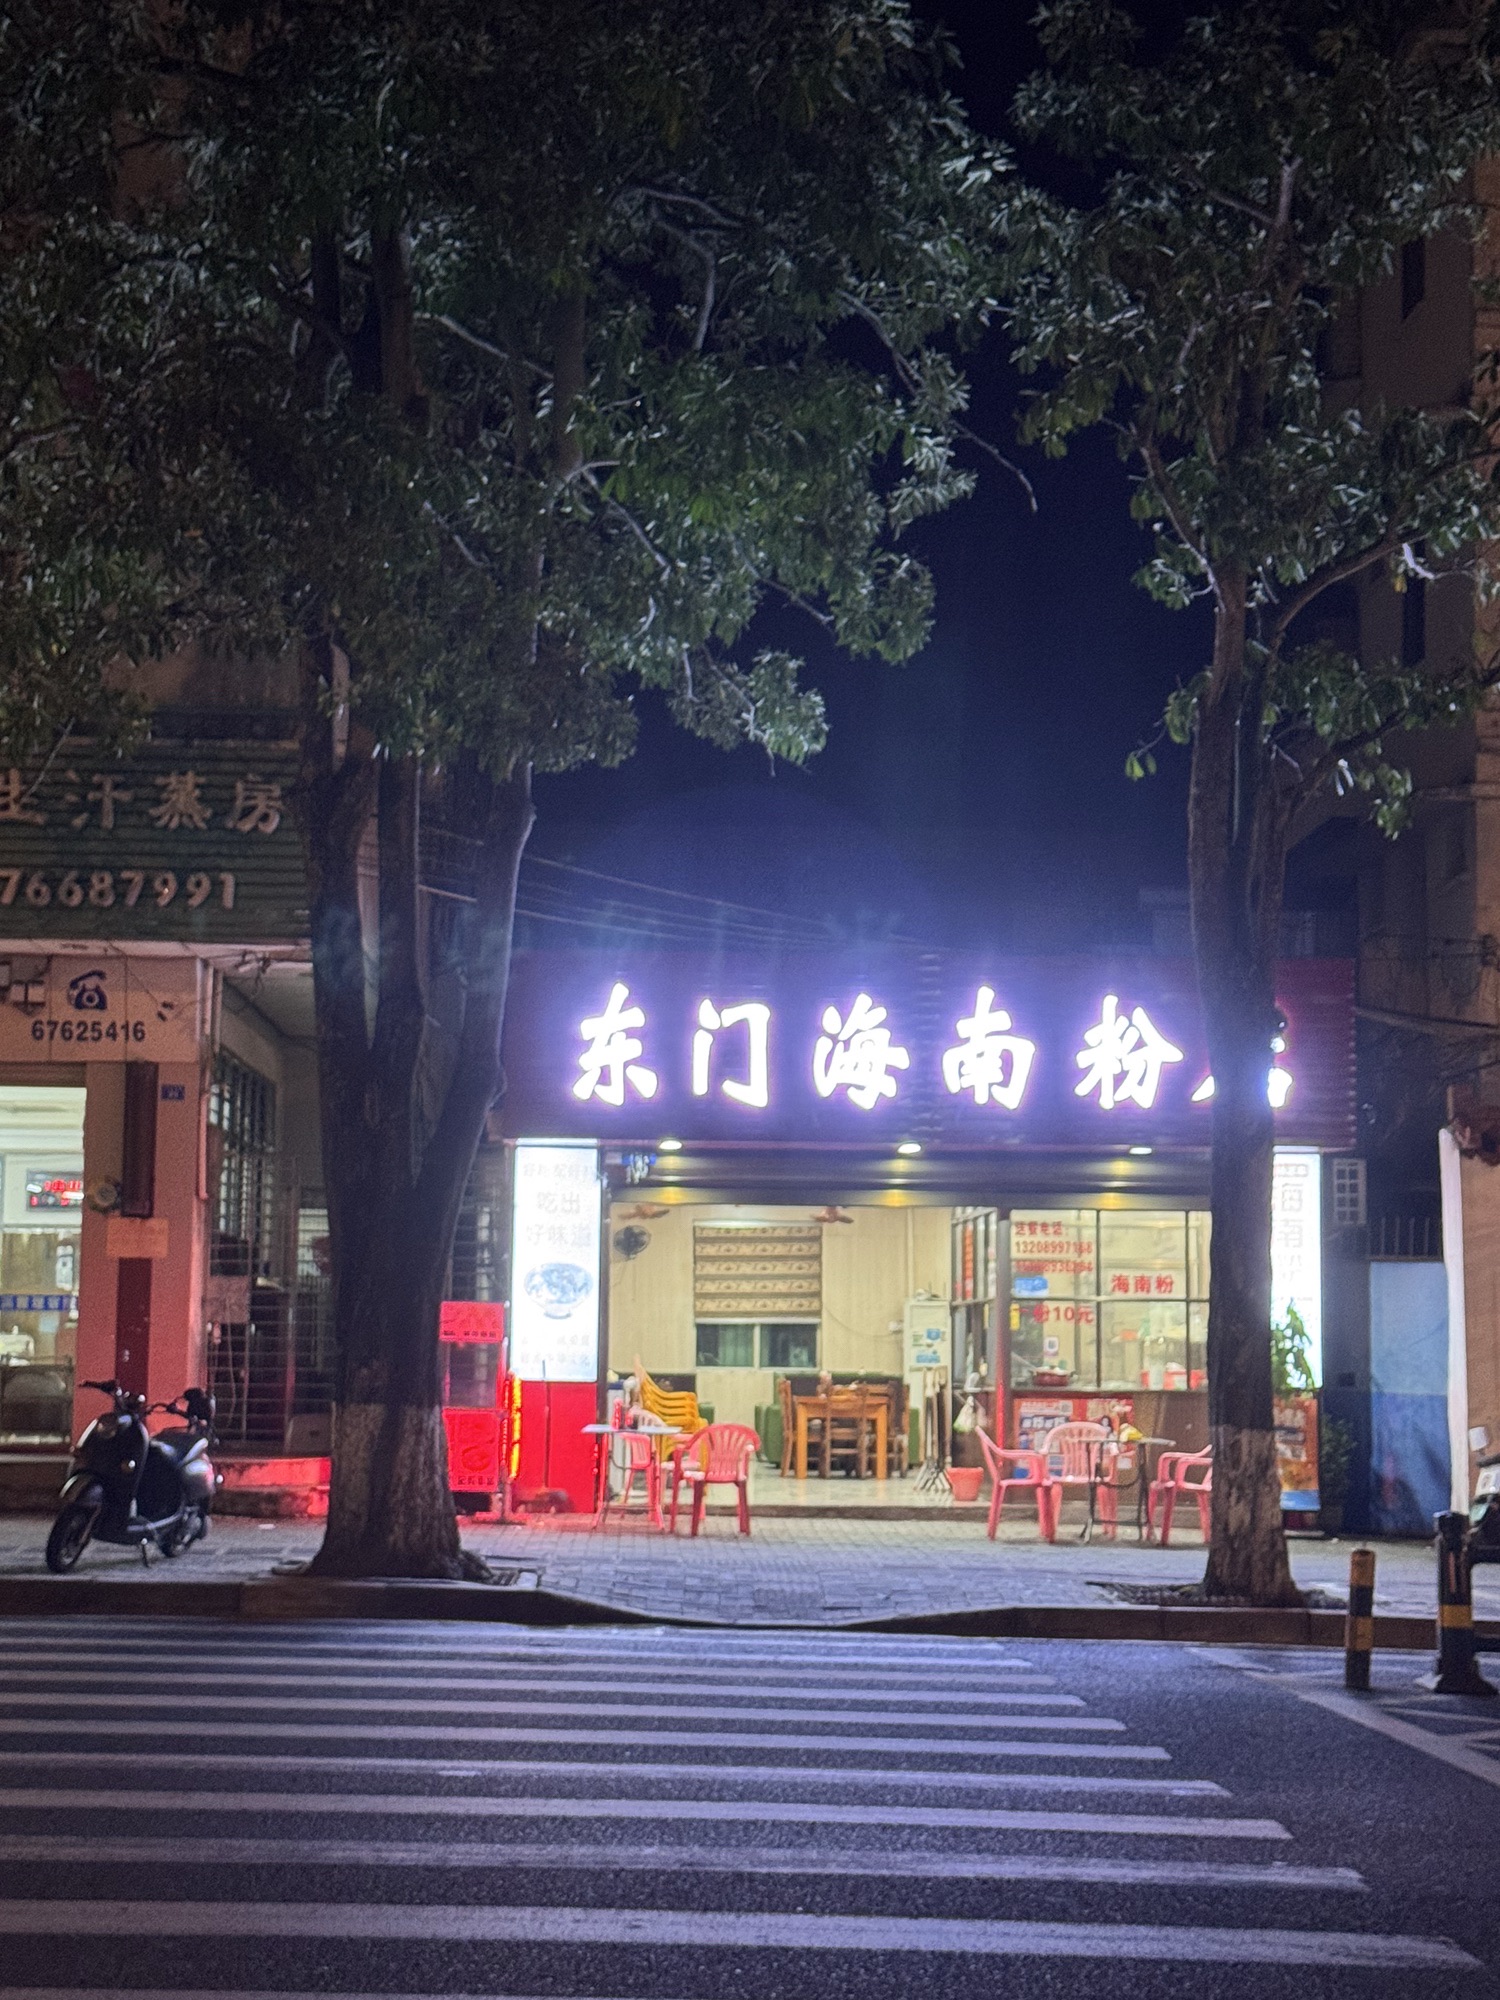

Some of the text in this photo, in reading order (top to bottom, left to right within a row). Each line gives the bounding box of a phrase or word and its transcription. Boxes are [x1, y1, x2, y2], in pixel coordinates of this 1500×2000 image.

[31, 1020, 146, 1042] 67625416
[572, 982, 1293, 1110] 东门海南粉
[1110, 1274, 1174, 1295] 海南粉
